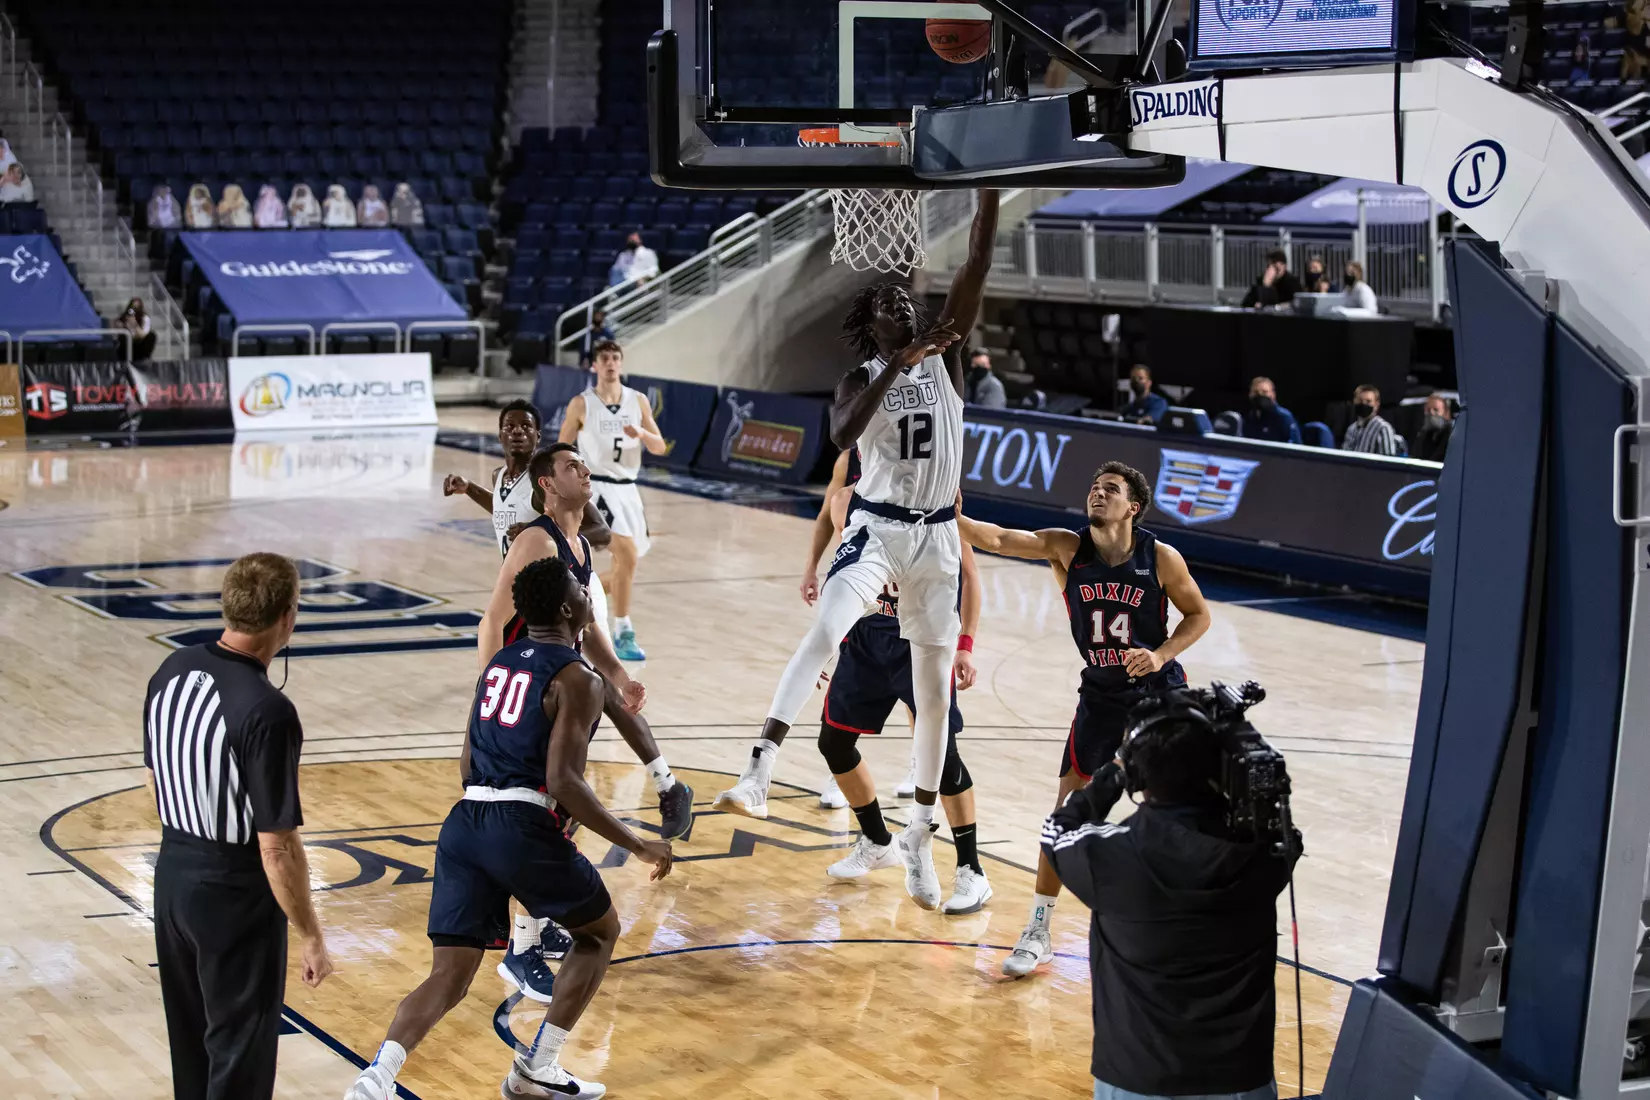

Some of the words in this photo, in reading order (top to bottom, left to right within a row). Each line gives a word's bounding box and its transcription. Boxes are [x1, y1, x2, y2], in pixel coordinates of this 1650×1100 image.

[1228, 7, 1270, 20] SPORTS
[1132, 82, 1219, 126] SPALDING
[883, 381, 938, 412] CBU
[613, 438, 623, 462] 5
[898, 413, 932, 460] 12
[1079, 582, 1145, 608] DIXIE
[1091, 608, 1131, 647] 14
[1087, 648, 1128, 667] STAT
[480, 664, 533, 728] 30
